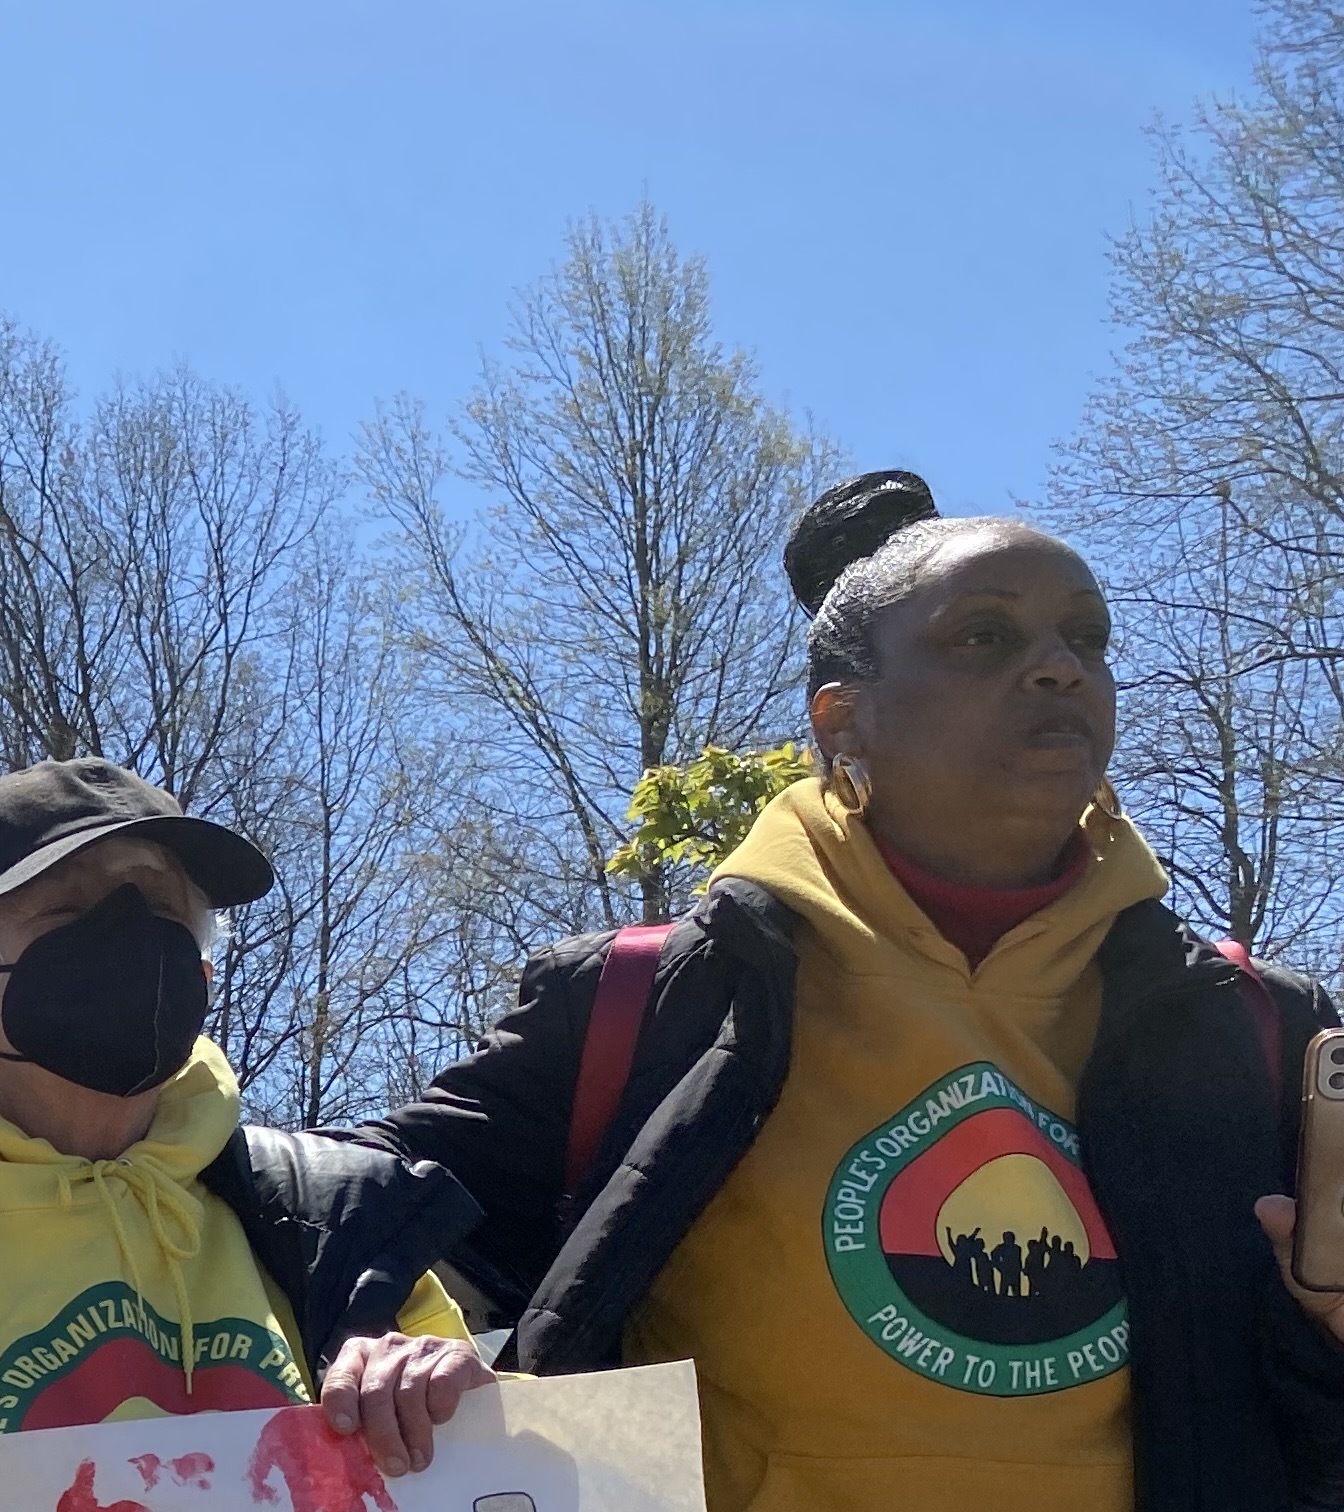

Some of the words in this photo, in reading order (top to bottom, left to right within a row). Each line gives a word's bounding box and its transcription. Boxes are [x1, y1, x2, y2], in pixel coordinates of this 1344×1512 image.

[834, 1150, 887, 1252] PEOPLE'S
[1, 1298, 180, 1389] ORGANIZATION
[193, 1332, 253, 1362] FOR
[867, 1304, 955, 1376] POWER
[962, 1354, 996, 1388] TO
[1009, 1357, 1059, 1389] THE
[1067, 1320, 1130, 1378] PEOP
